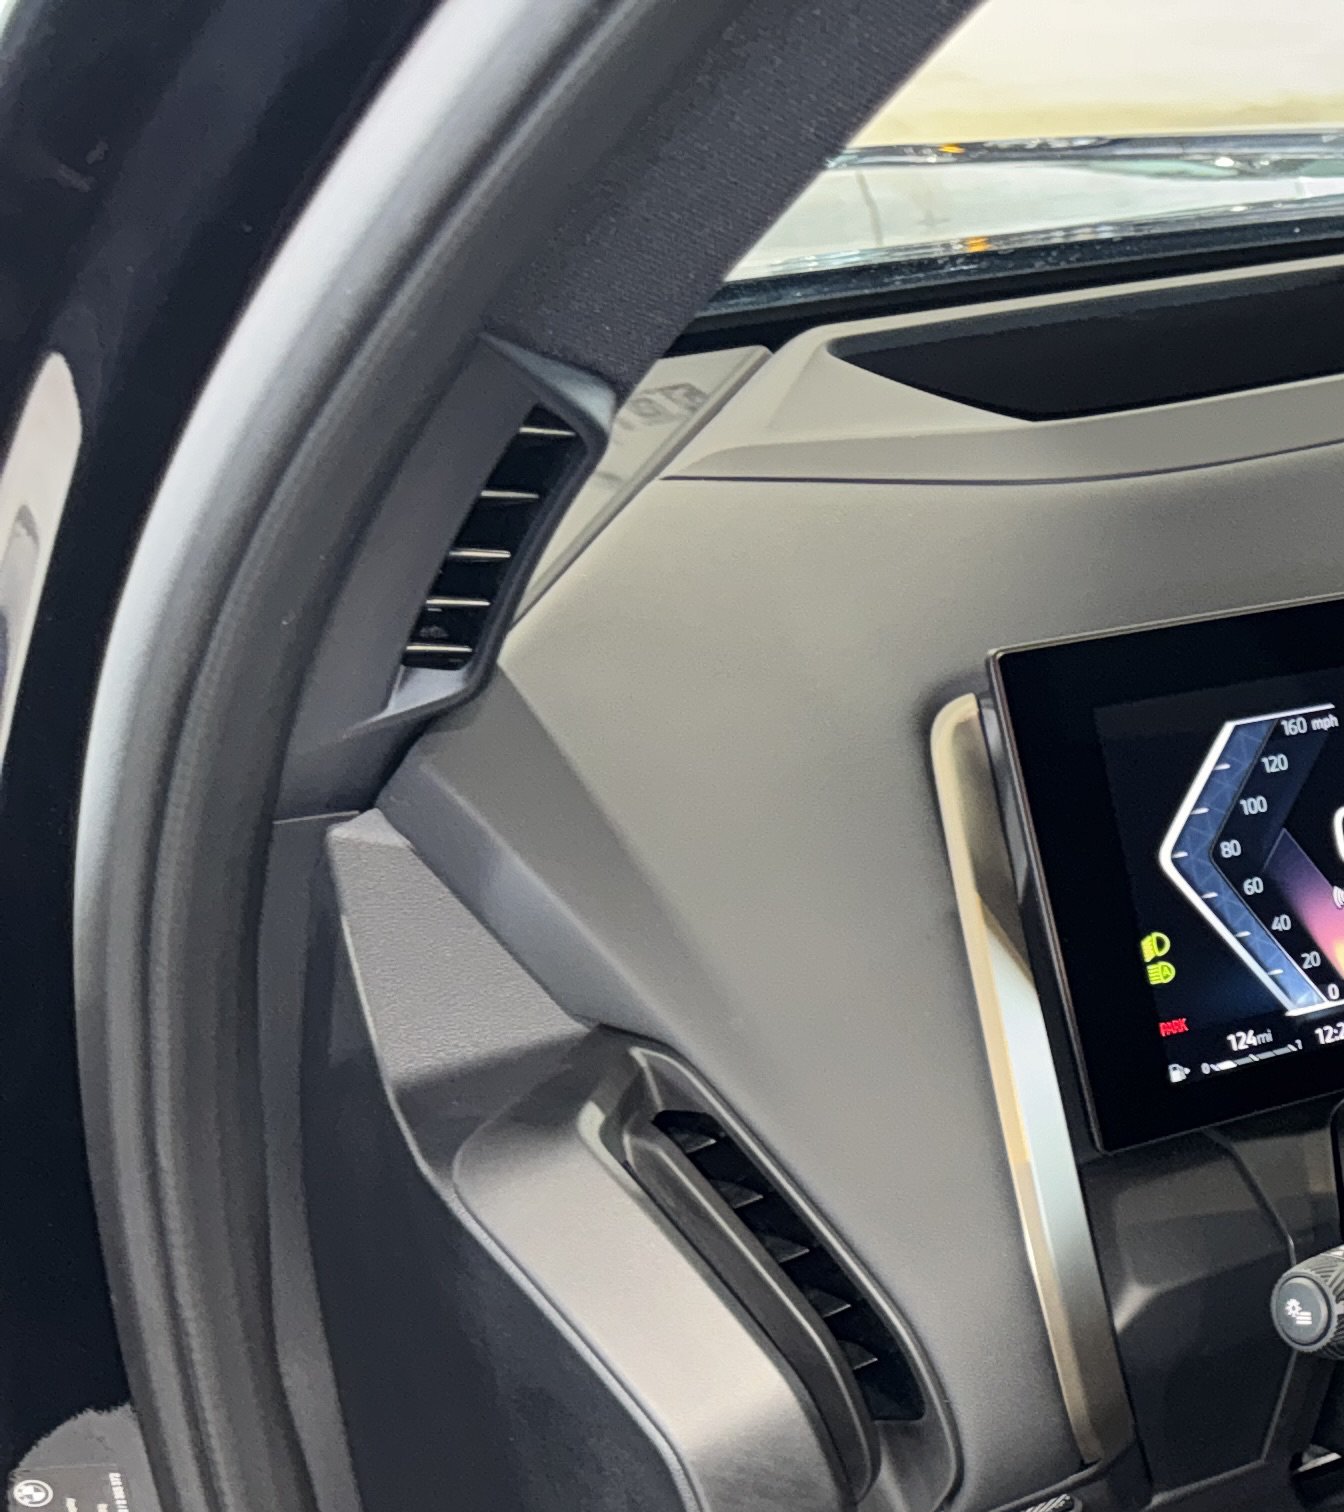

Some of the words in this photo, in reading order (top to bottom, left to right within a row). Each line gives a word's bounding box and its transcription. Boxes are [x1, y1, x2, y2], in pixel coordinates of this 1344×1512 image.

[1281, 717, 1307, 736] 160
[1312, 714, 1339, 732] mph
[1262, 754, 1288, 774] 120
[1240, 796, 1267, 815] 100
[1220, 840, 1242, 858] 80
[1243, 877, 1264, 895] 60
[1271, 915, 1292, 932] 40
[1301, 952, 1322, 970] 20
[1327, 983, 1340, 1000] 0
